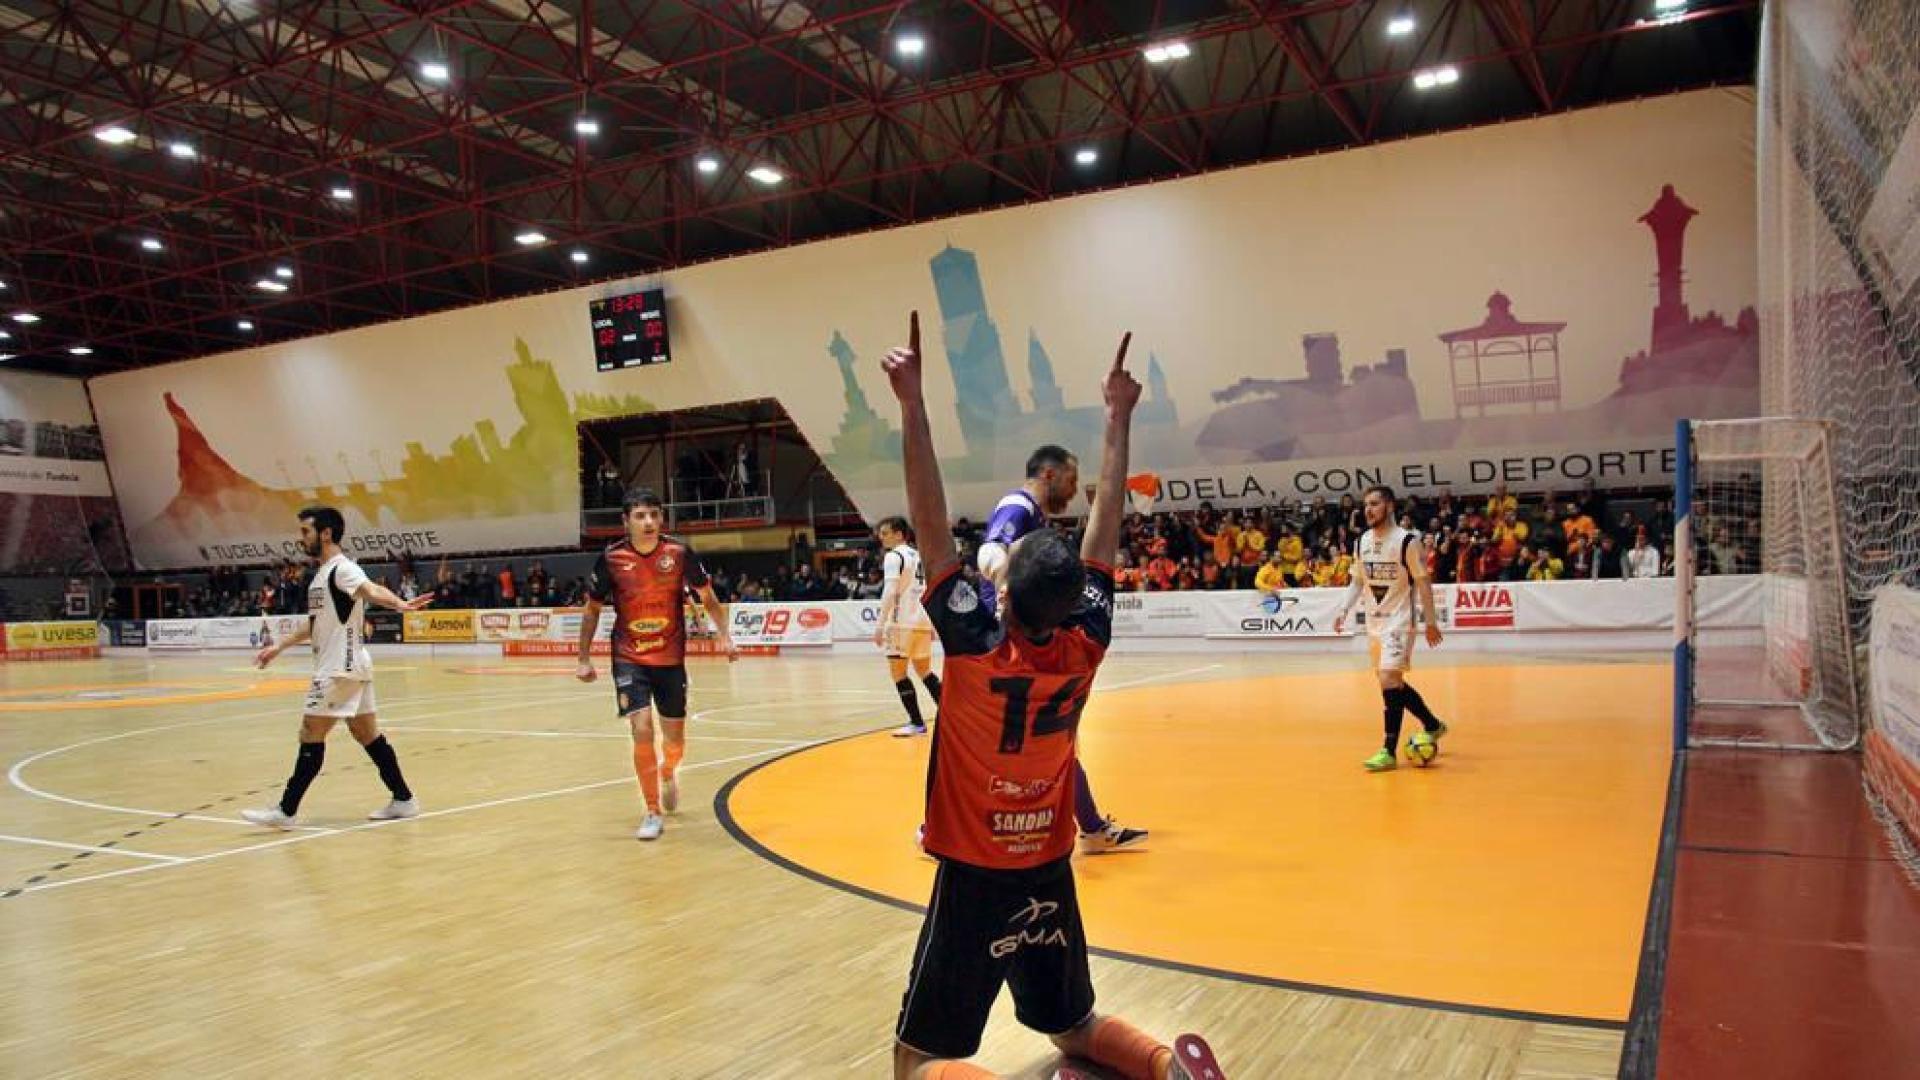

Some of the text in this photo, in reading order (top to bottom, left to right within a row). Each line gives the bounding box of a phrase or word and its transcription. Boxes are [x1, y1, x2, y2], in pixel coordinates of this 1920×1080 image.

[1295, 467, 1383, 493] CON
[1401, 464, 1451, 488] EL
[350, 531, 441, 552] DEPORTE
[42, 627, 97, 642] uvesa
[1240, 617, 1315, 632] GIMA
[989, 675, 1089, 754] 14
